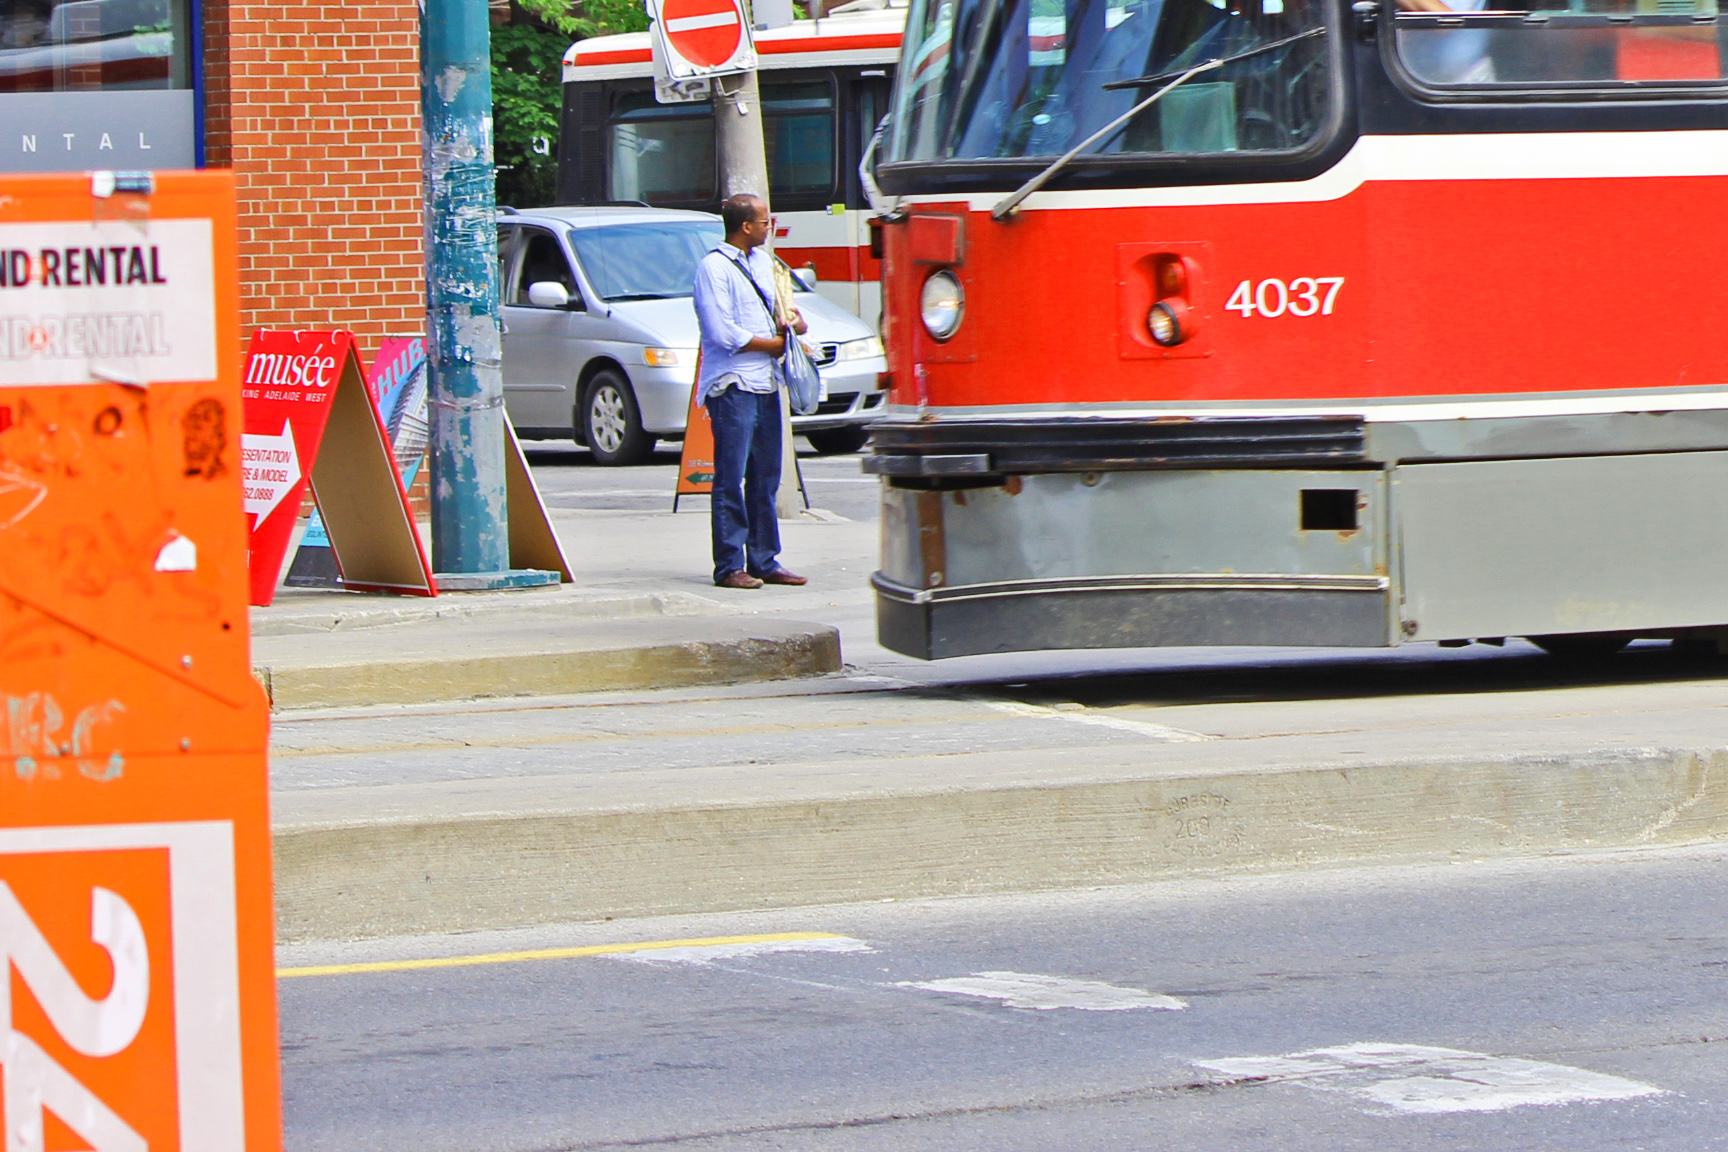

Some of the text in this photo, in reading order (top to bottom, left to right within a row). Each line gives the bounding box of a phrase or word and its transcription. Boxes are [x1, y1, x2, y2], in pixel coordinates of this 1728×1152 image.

[41, 244, 167, 288] RENTAL
[1224, 276, 1346, 318] 4037
[245, 344, 335, 388] musée
[377, 337, 424, 401] HUB
[242, 389, 327, 403] KING ADELAIDE WEST
[260, 469, 289, 483] MODEL
